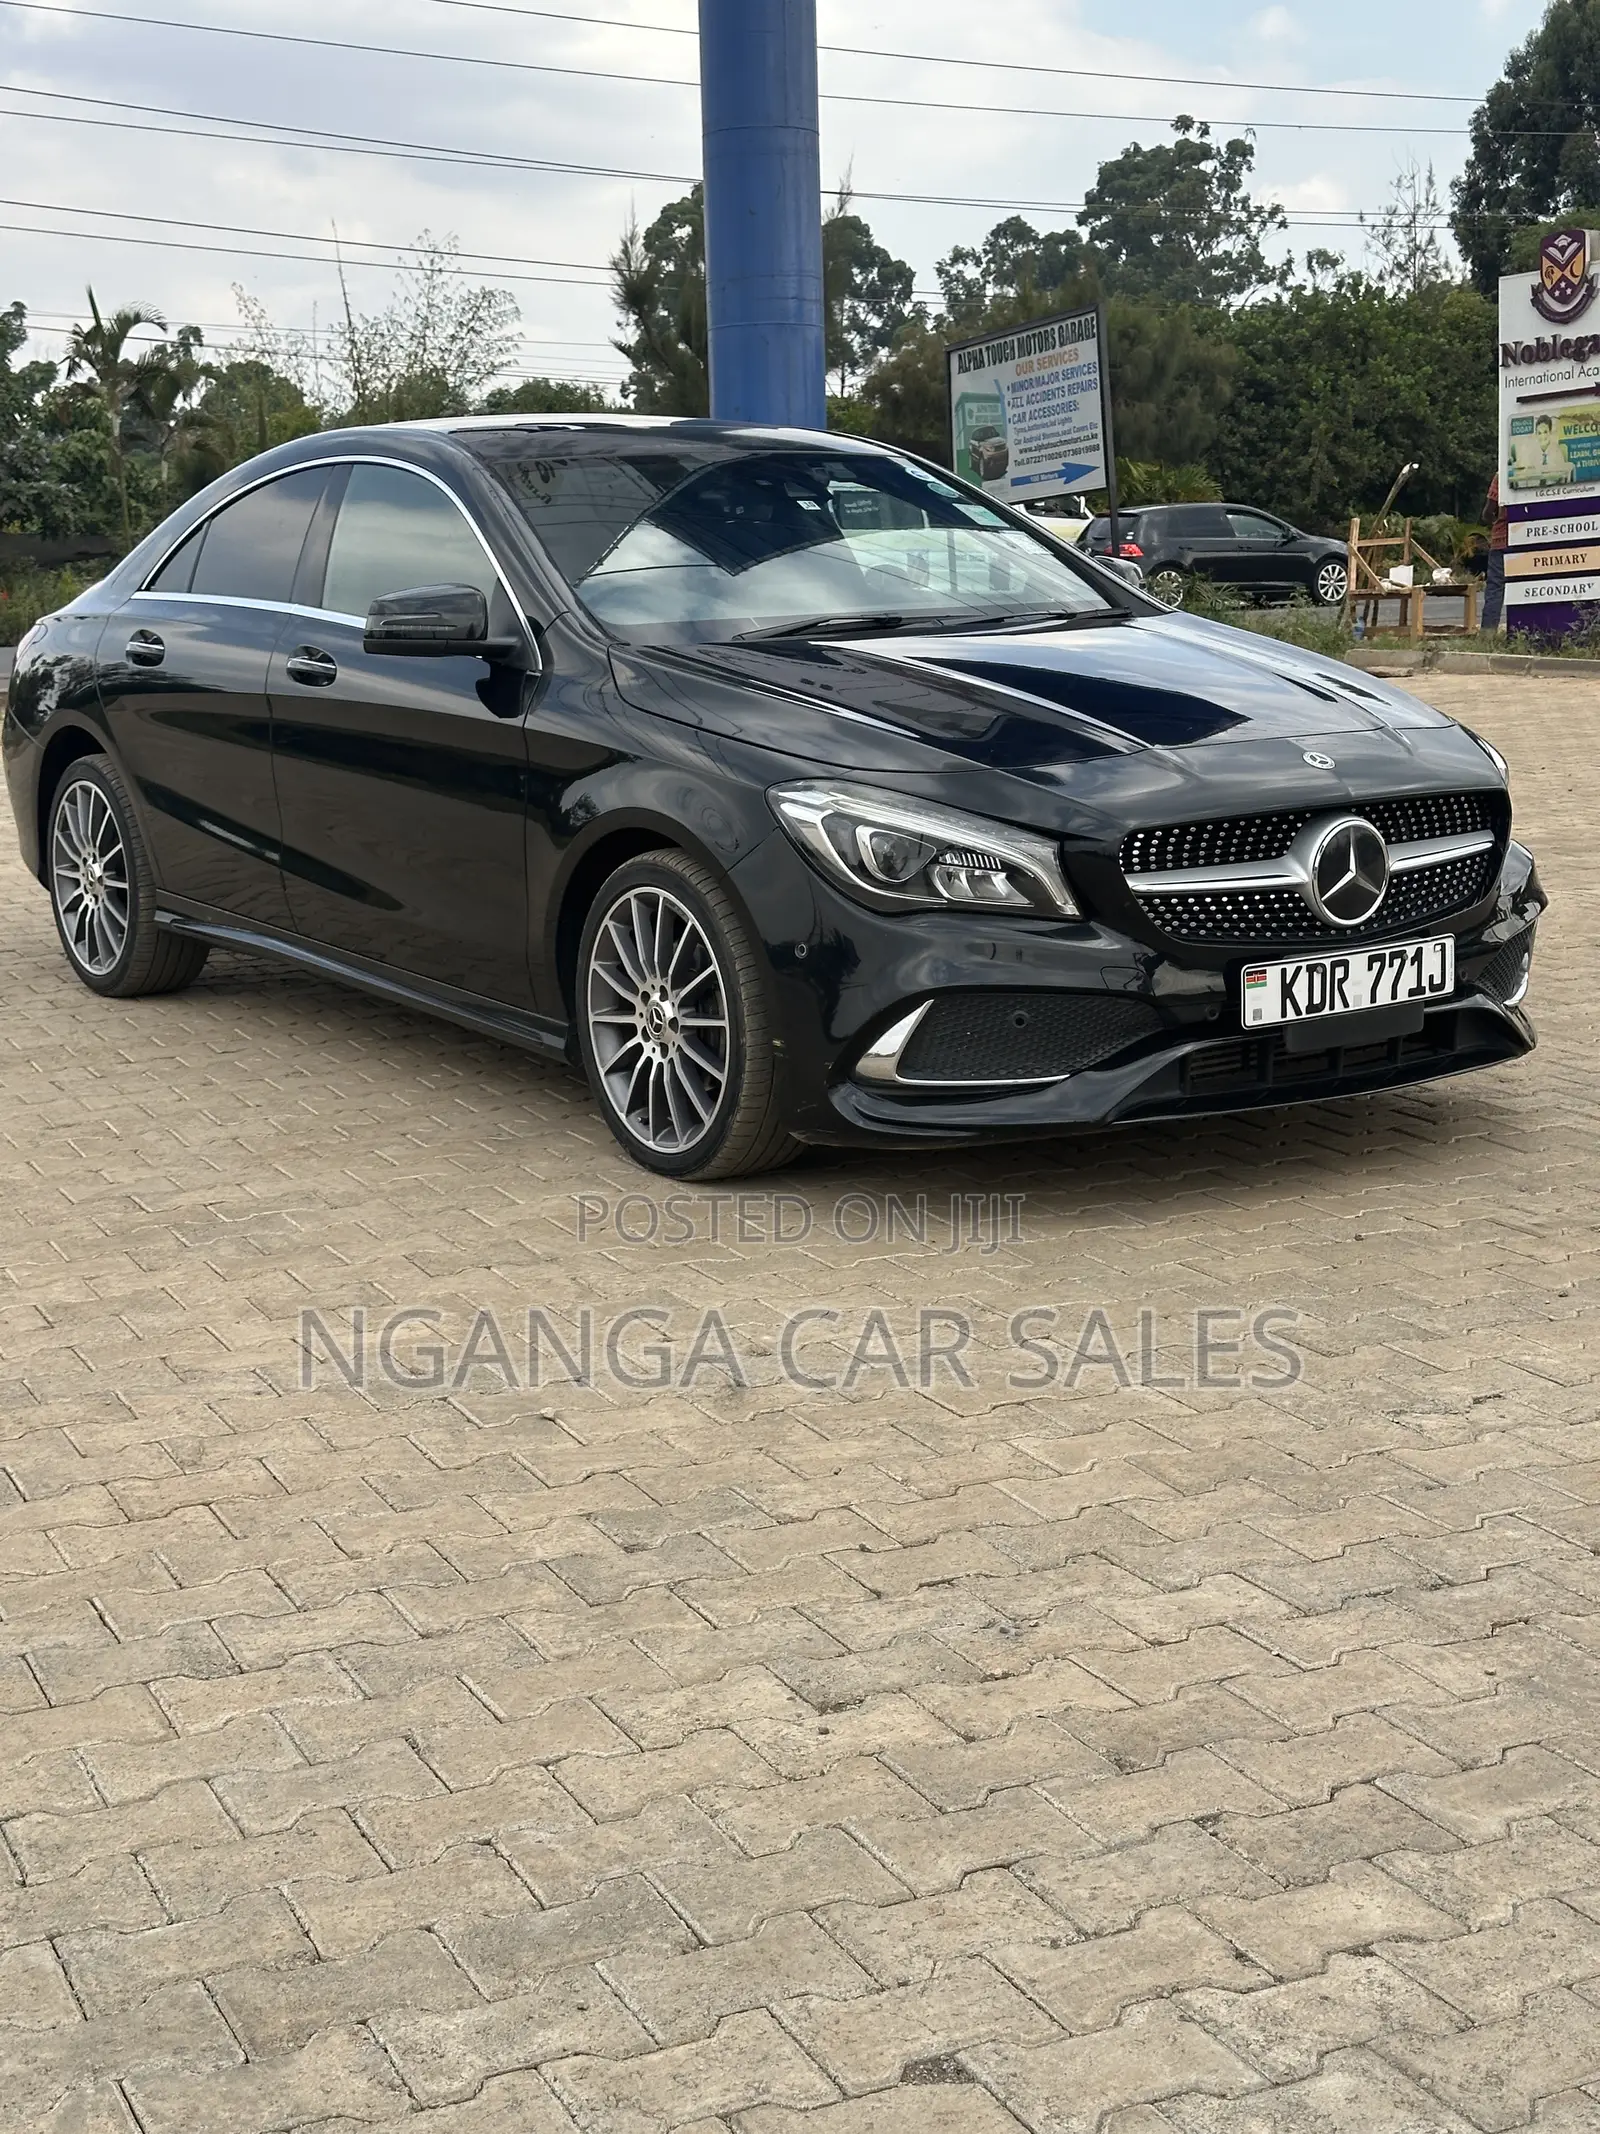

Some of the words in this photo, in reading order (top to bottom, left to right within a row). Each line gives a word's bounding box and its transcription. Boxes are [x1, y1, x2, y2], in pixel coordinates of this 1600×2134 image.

[957, 347, 986, 375] ALPHA
[985, 339, 1016, 368] TOUCH
[1016, 327, 1056, 359] MOTORS
[1057, 316, 1096, 348] GARAGE
[1015, 360, 1035, 377] OUR
[1036, 347, 1080, 371] SERVICES
[1061, 361, 1098, 381] SERVICES
[1504, 365, 1574, 388] International
[1011, 396, 1025, 410] ALL
[1025, 385, 1066, 407] ACCIDENTS
[1067, 377, 1098, 397] REPAIRS
[1012, 411, 1027, 425] CAR
[1563, 423, 1600, 436] WELCO
[1562, 486, 1596, 495] Curriculum
[1526, 521, 1599, 538] PRE-SCHOOL
[1533, 553, 1588, 567] PRIMARY
[1280, 958, 1350, 1019] KDR
[1367, 942, 1447, 1004] 771J
